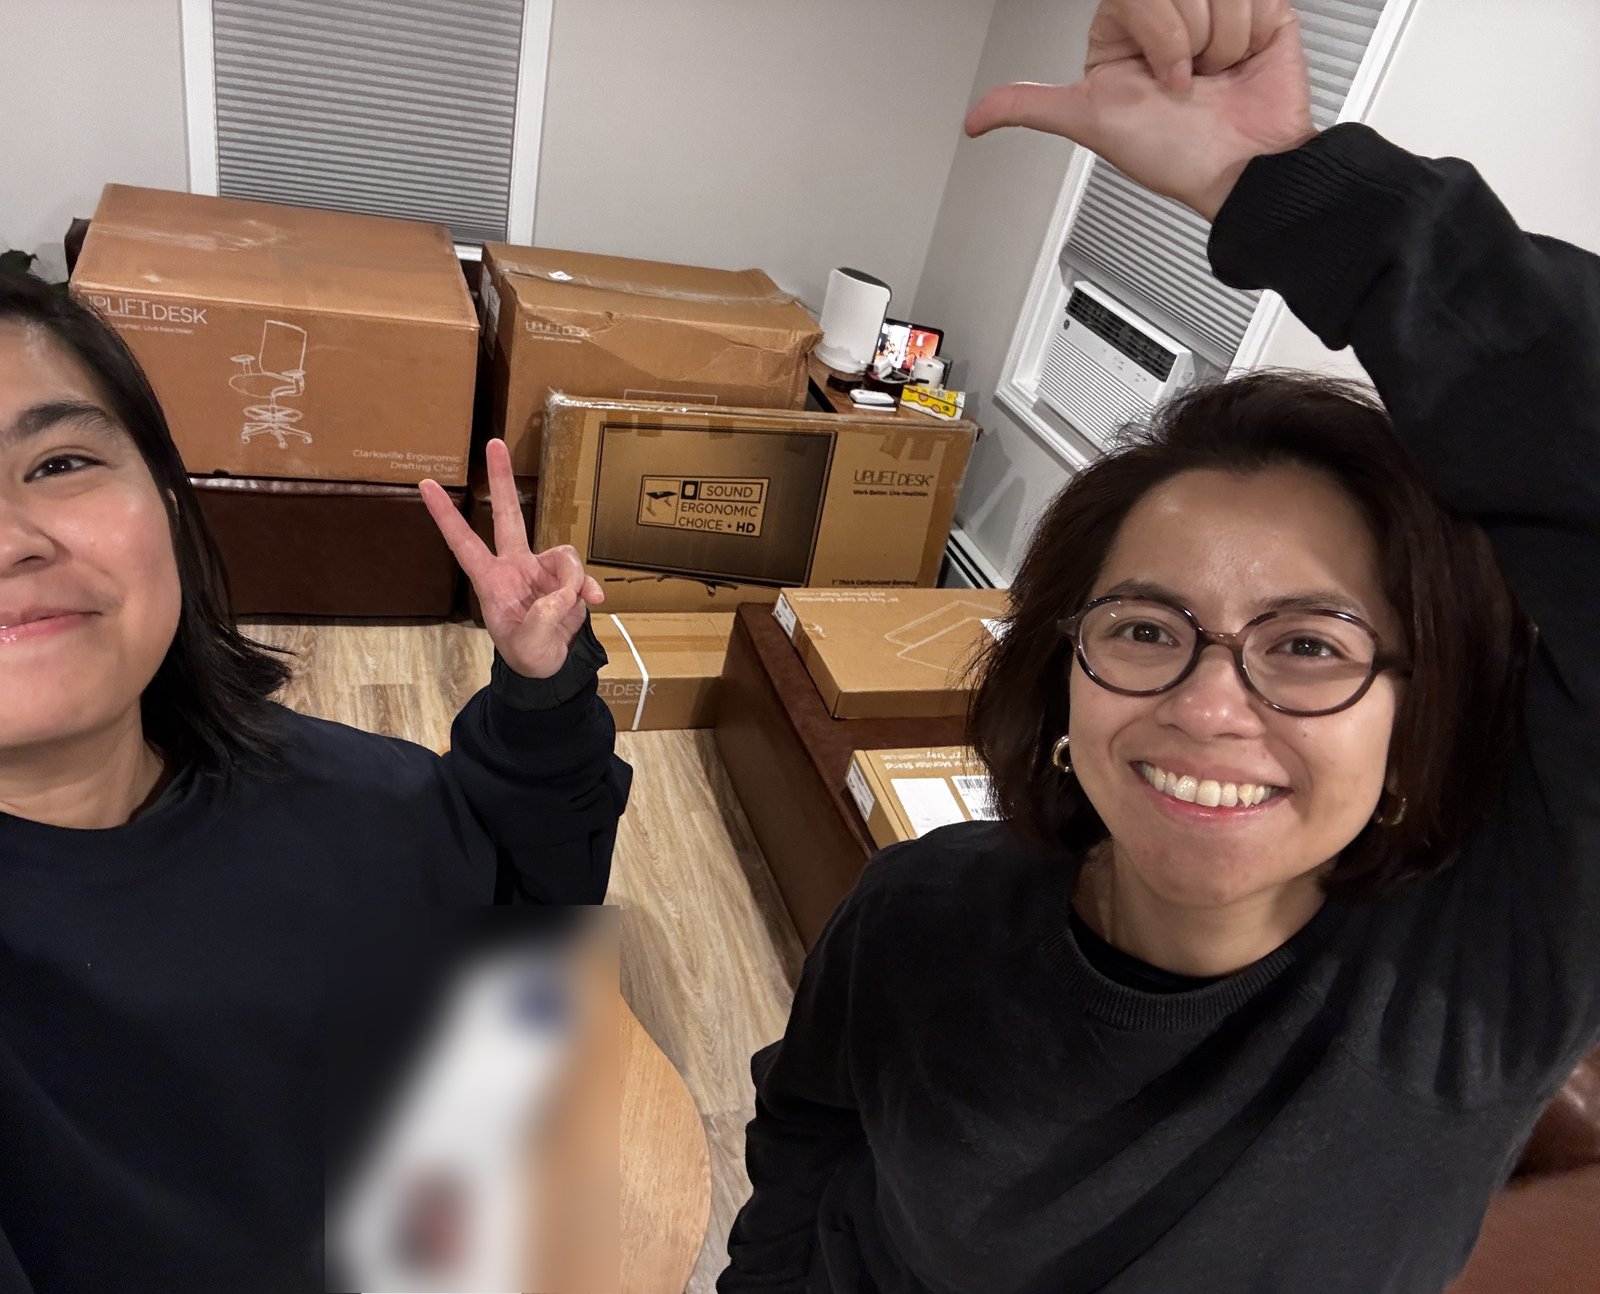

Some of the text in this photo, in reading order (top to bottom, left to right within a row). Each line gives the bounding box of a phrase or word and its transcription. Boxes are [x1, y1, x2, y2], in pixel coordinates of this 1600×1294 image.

[151, 303, 208, 325] DESK
[352, 449, 462, 463] Clarksville Ergonomic
[390, 461, 460, 473] Drafting Chair
[853, 469, 931, 487] UPLIFT DESK
[706, 485, 753, 498] SOUND
[680, 502, 759, 518] ERGONOMIC
[678, 516, 756, 534] CHOICE HD
